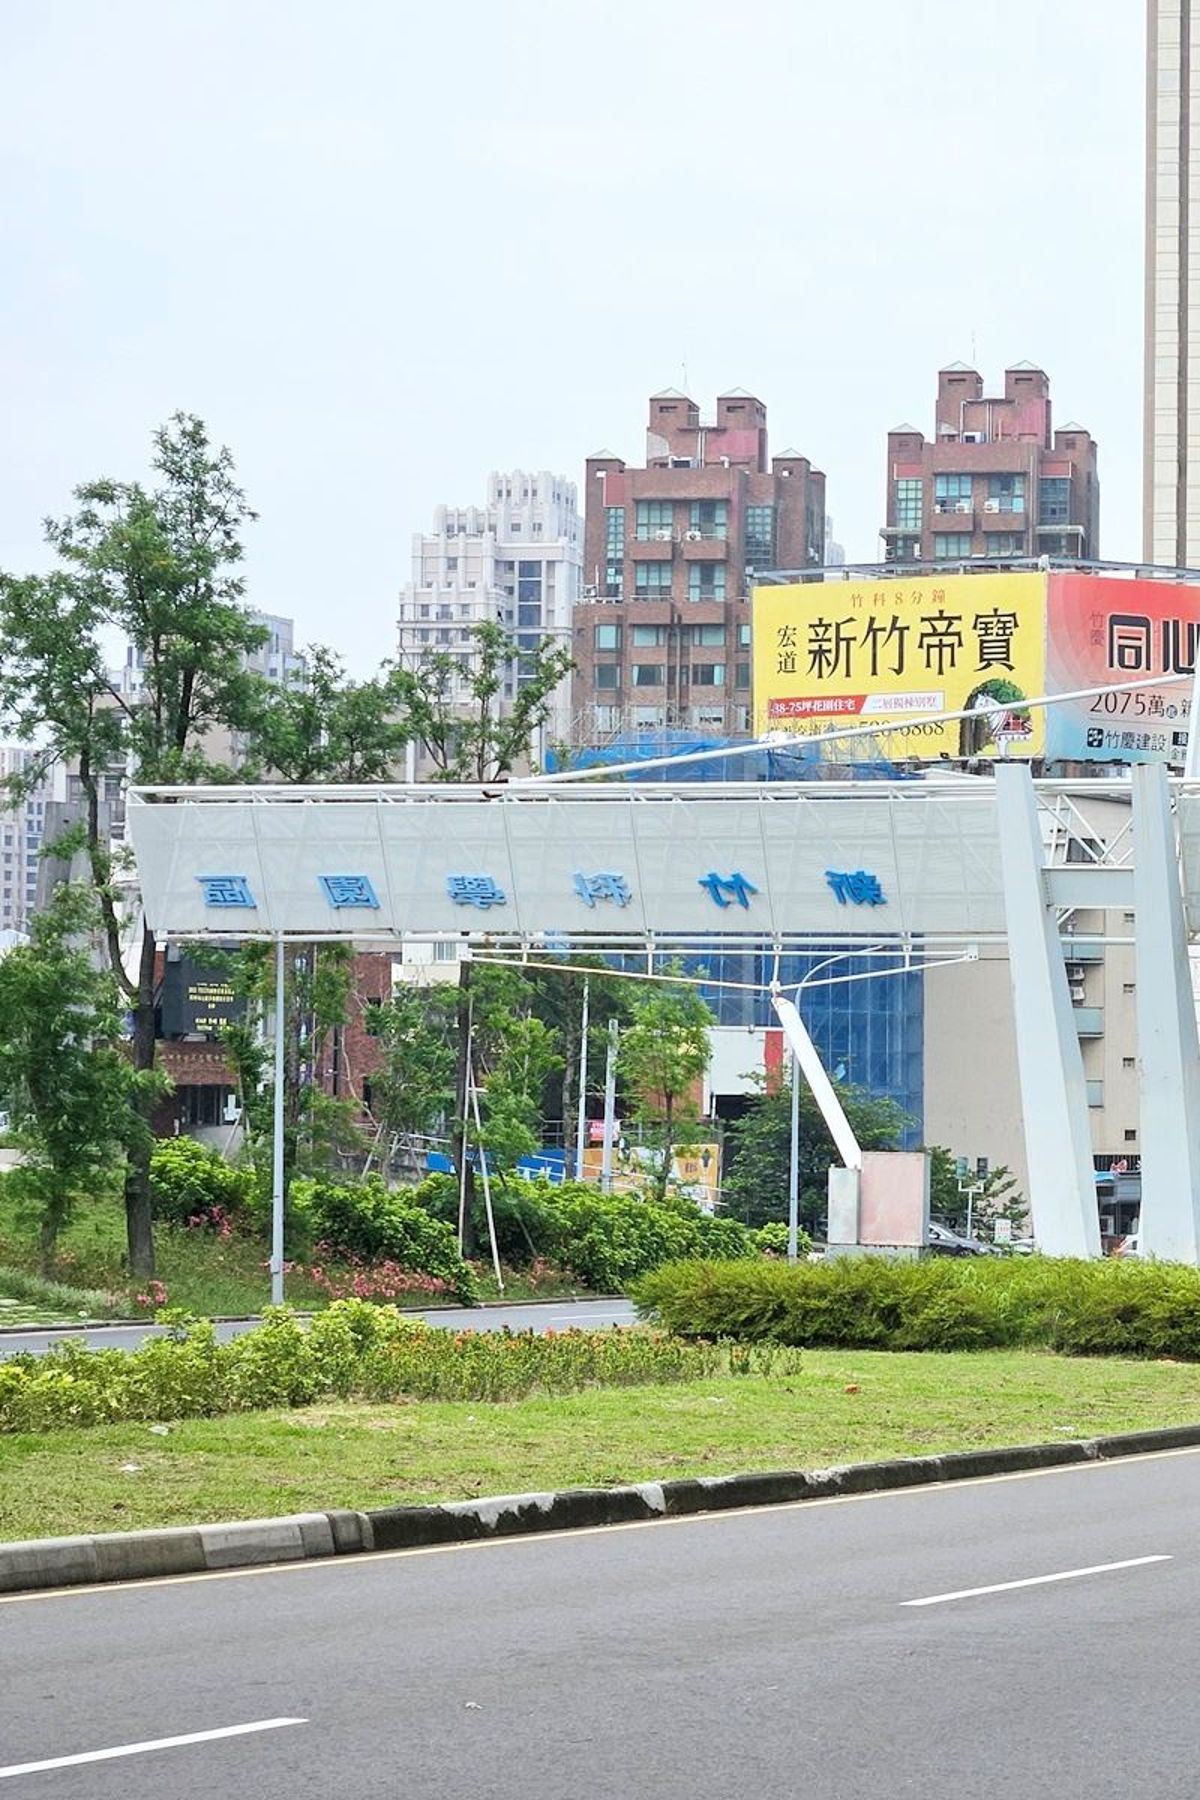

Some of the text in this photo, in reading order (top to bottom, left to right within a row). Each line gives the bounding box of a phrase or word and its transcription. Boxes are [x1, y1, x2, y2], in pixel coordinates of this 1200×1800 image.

[776, 625, 797, 674] 宏道
[806, 607, 1020, 679] 新竹帝寶
[1104, 729, 1168, 752] 竹慶建設
